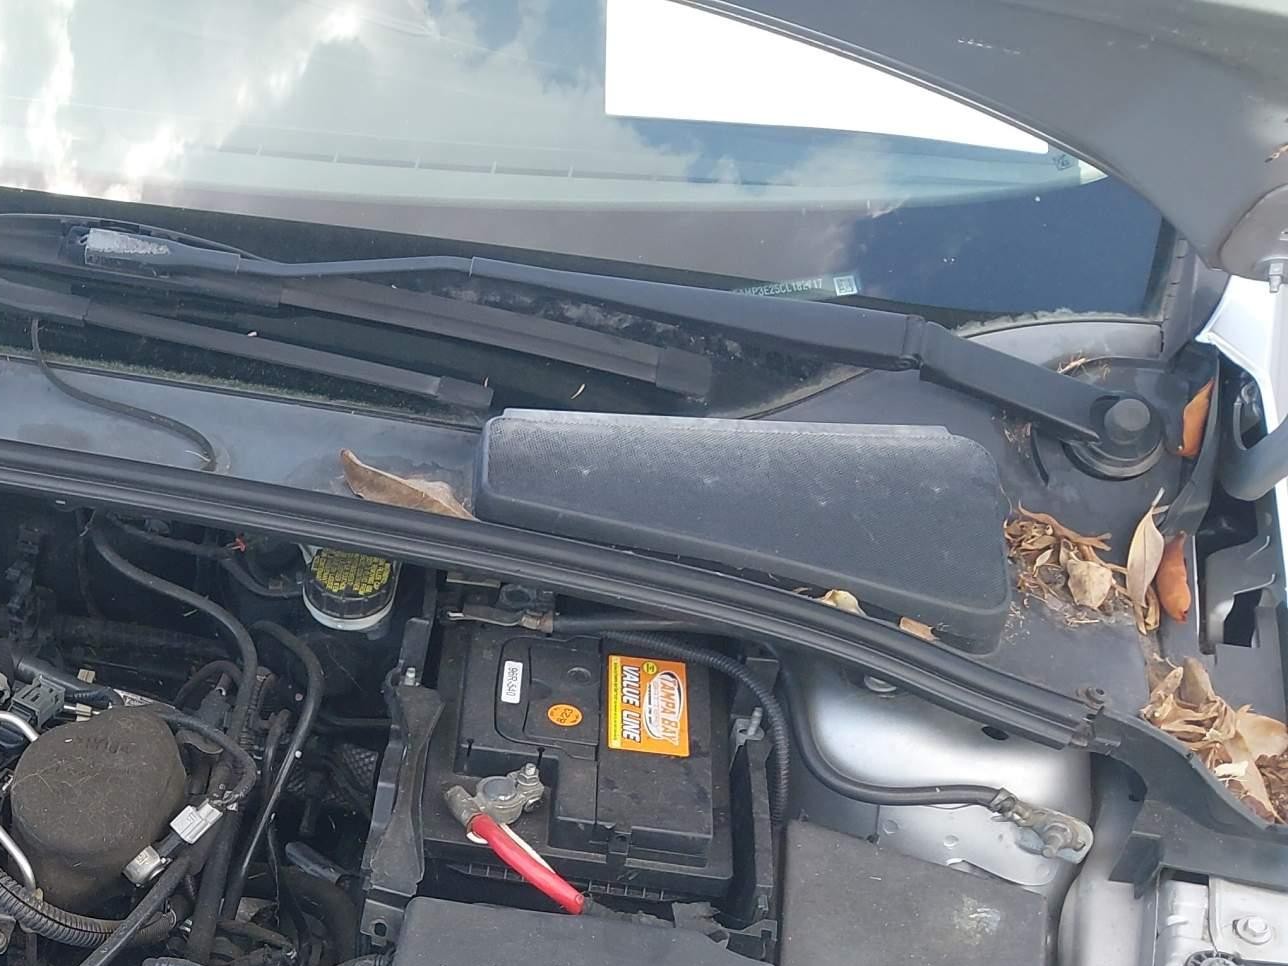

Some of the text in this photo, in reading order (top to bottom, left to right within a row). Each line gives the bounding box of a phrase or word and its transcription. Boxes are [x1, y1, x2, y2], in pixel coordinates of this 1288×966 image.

[622, 665, 641, 743] VALUE LINE
[659, 676, 680, 746] TAMPA BAY
